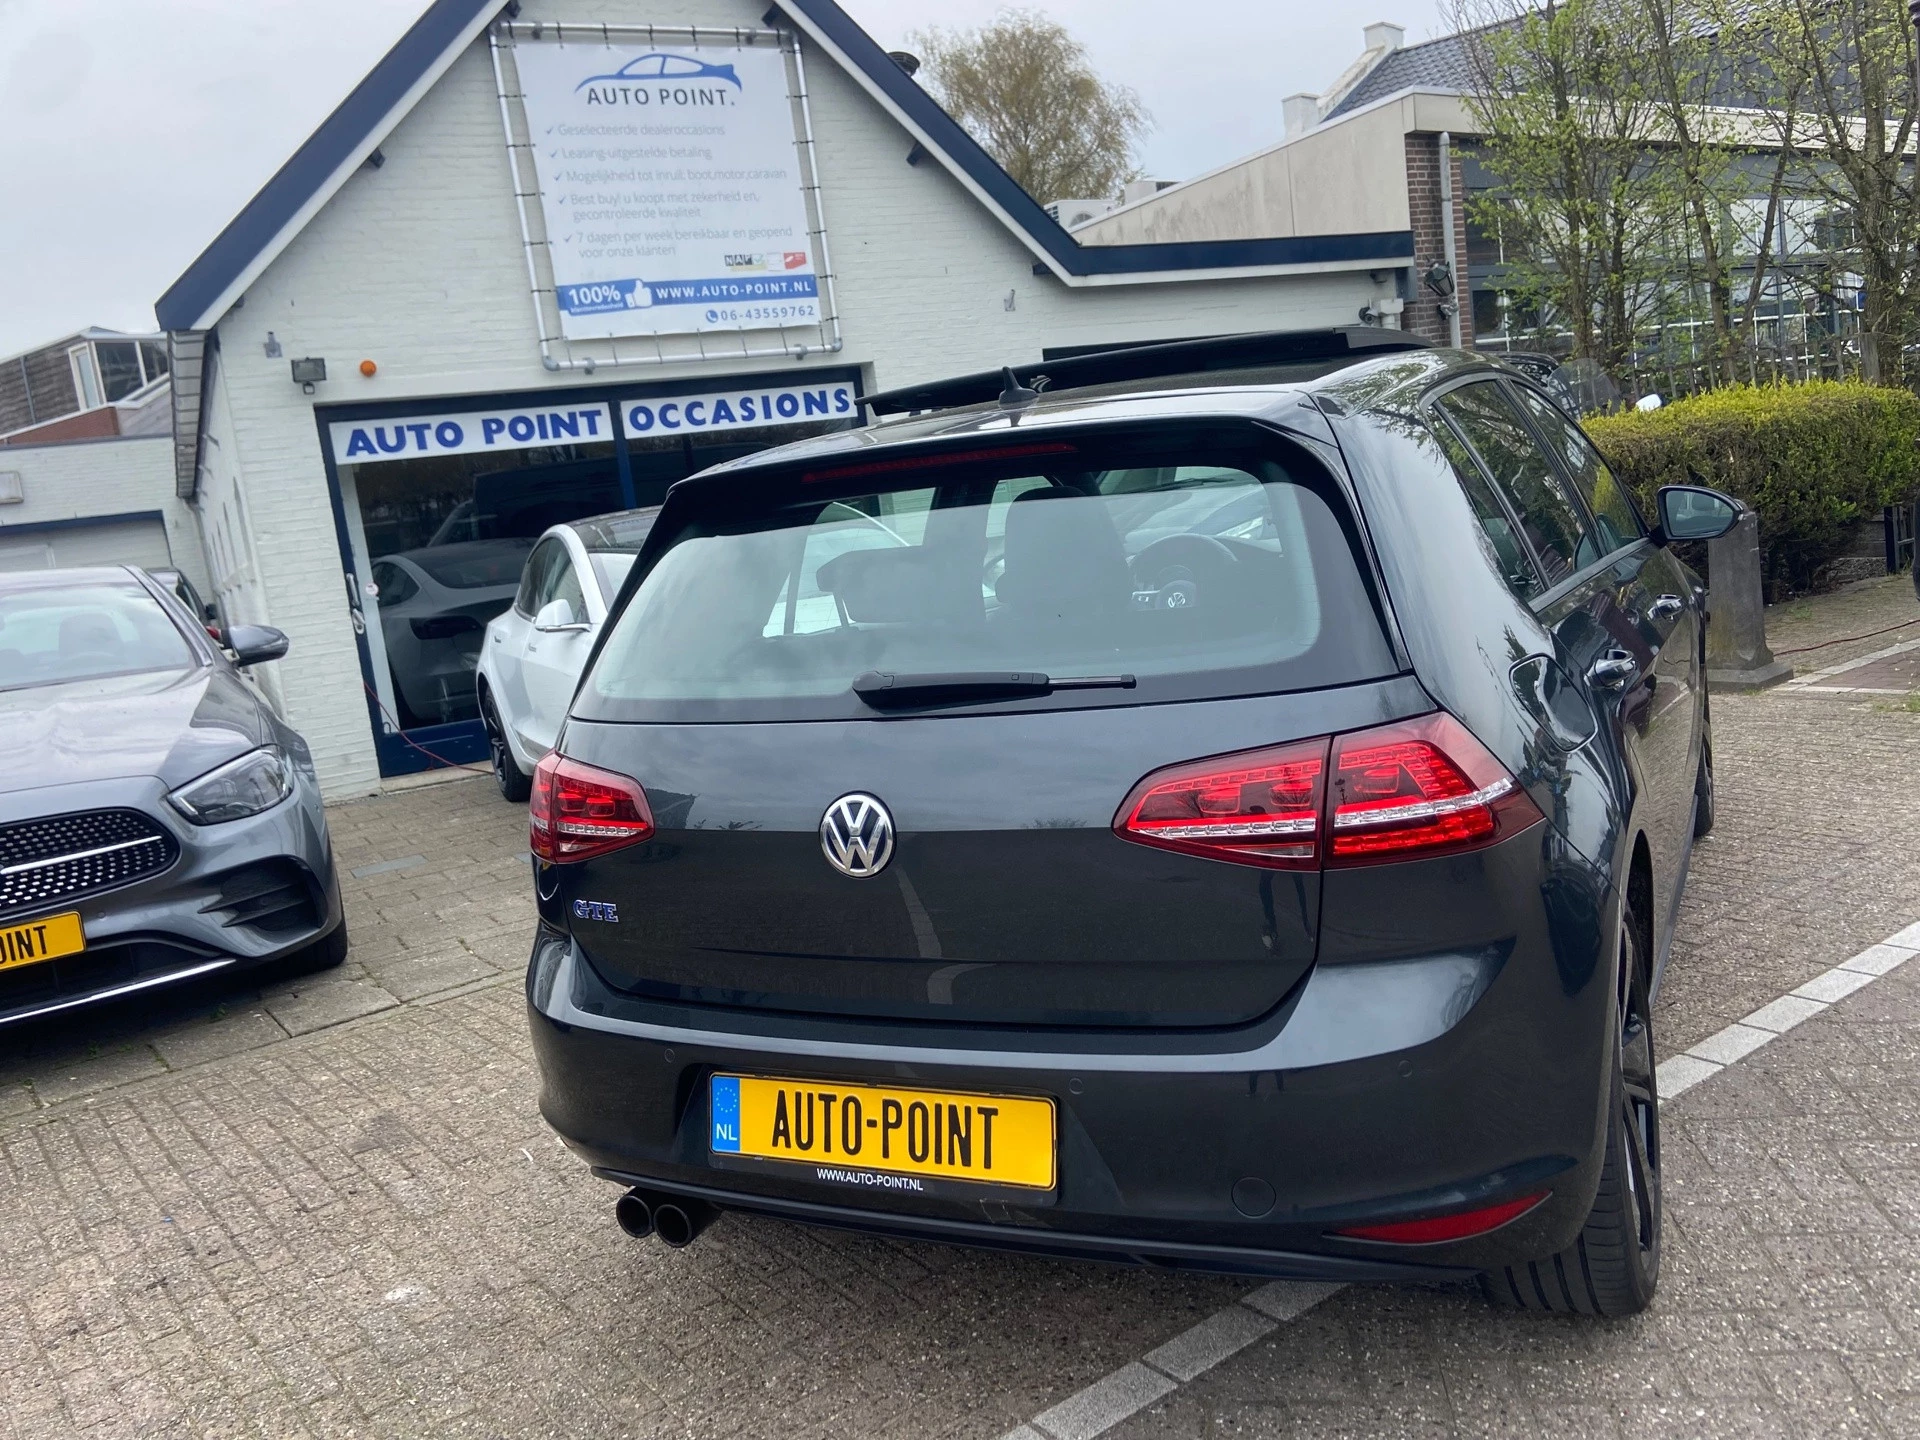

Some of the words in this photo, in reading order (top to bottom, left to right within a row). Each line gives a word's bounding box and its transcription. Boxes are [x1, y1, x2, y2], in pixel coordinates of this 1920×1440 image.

[587, 87, 649, 105] AUTO
[558, 123, 637, 136] Geselecteerde
[669, 146, 712, 160] betaling
[566, 169, 634, 184] Mogelijkheid
[637, 170, 653, 181] tot
[570, 193, 595, 205] Best
[624, 195, 632, 204] u
[634, 192, 664, 206] koopt
[667, 192, 689, 203] met
[691, 190, 741, 202] zekerheid
[573, 208, 656, 223] gecontroleerde
[576, 231, 584, 243] 7
[587, 231, 621, 245] dagen
[624, 232, 642, 245] per
[644, 230, 673, 241] week
[675, 227, 729, 240] bereikbaar
[733, 229, 746, 239] en
[748, 226, 793, 241] geopend
[579, 247, 604, 258] voor
[607, 246, 633, 257] onze
[635, 244, 677, 257] klanten
[568, 285, 622, 306] 100%
[656, 281, 812, 299] WWW.AUTO-POINT.NL
[721, 305, 815, 321] 06-43559762
[346, 421, 464, 457] AUTO
[484, 409, 603, 445] POINT
[628, 388, 851, 432] OCCASIONS
[572, 899, 619, 923] GTE
[716, 1123, 737, 1141] NL
[772, 1089, 999, 1170] AUTO-POINT
[816, 1168, 924, 1191] WWW.AUTO-POINT.NL
